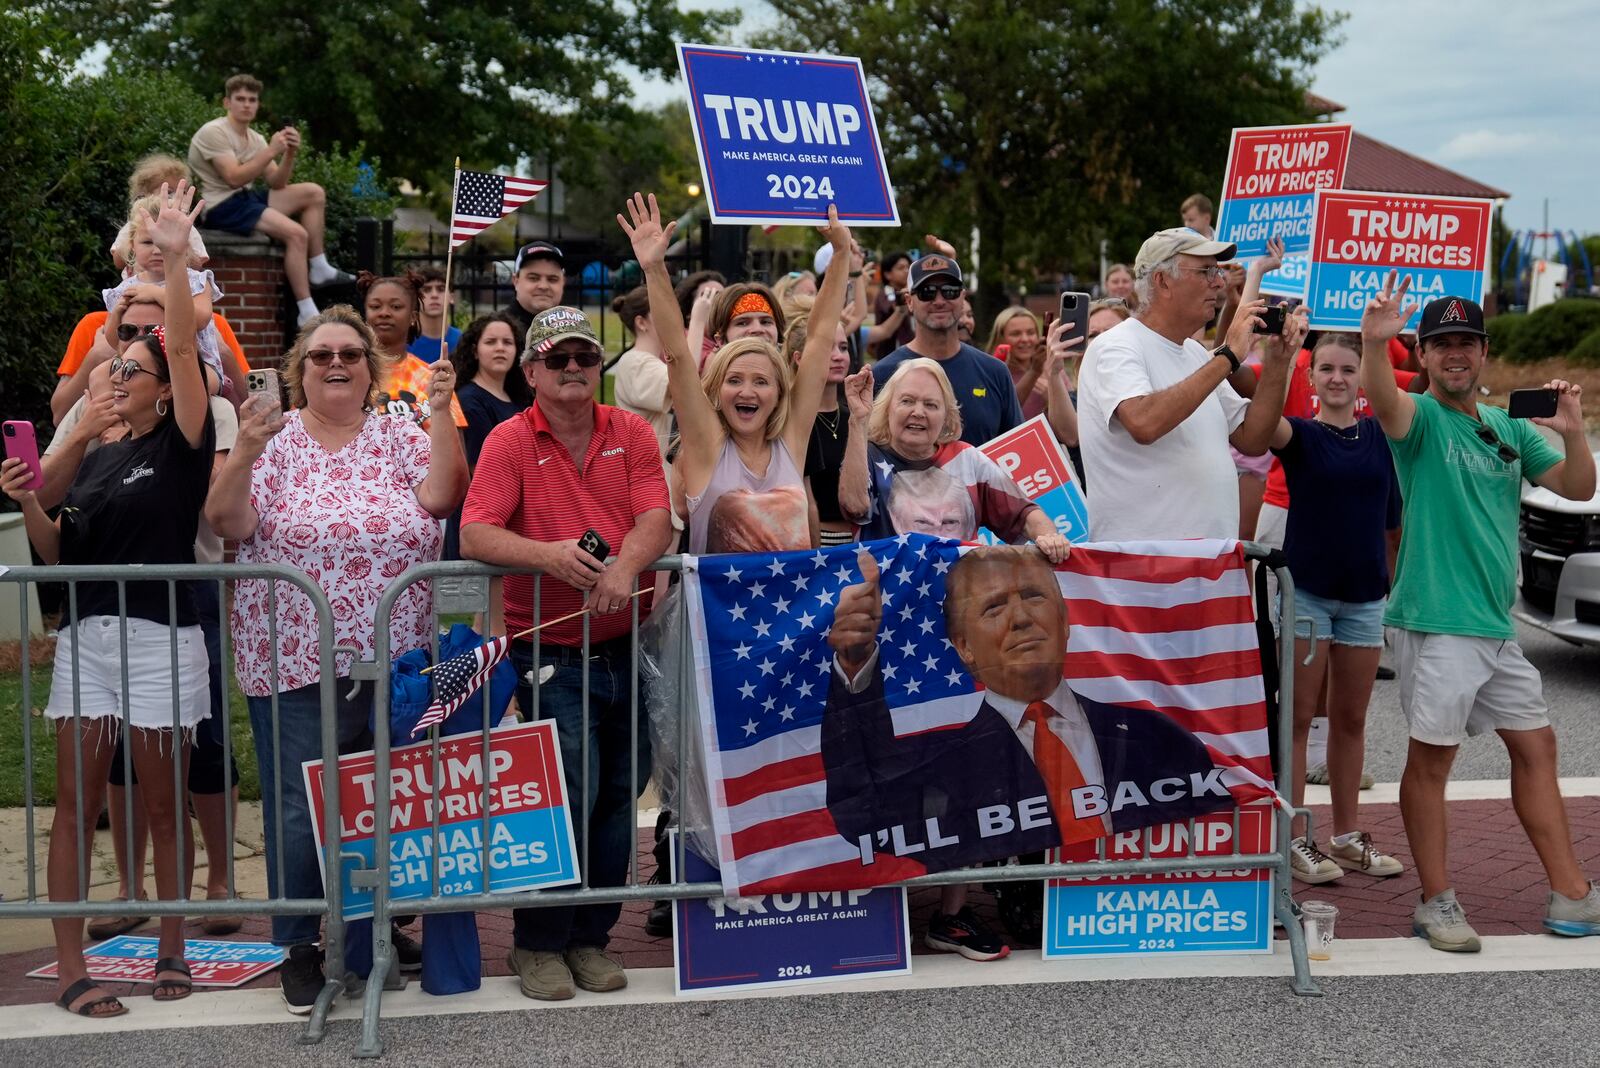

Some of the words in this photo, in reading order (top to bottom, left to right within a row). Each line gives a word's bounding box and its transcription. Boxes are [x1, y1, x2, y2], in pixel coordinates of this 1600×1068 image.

[703, 93, 861, 146] TRUMP
[722, 150, 750, 160] MAKE
[752, 151, 796, 163] AMERICA
[798, 154, 828, 164] GREAT
[831, 156, 863, 165] AGAIN!
[1253, 140, 1330, 171] TRUMP
[766, 173, 835, 200] 2024
[1235, 173, 1276, 195] LOW
[1278, 169, 1335, 192] PRICES
[1248, 198, 1313, 222] KAMALA
[1229, 223, 1269, 242] HIGH
[1272, 218, 1313, 239] PRICE
[1347, 209, 1460, 241] TRUMP
[1326, 239, 1384, 262] LOW
[1389, 242, 1472, 267] PRICES
[540, 310, 585, 327] TRUMP
[602, 447, 625, 456] GEOR
[352, 749, 513, 805] TRUMP
[424, 782, 542, 822] PRICES
[976, 794, 1052, 839] BE
[1070, 767, 1233, 820] BACK
[390, 822, 514, 863] KAMALA
[1096, 822, 1233, 855] RUMP
[438, 841, 549, 879] PRICES
[1096, 889, 1220, 912] KAMALA
[715, 920, 744, 930] MAKE
[747, 916, 793, 928] AMERICA
[796, 912, 829, 923] GREAT
[832, 909, 867, 920] AGAIN!
[1067, 912, 1137, 936] HIGH
[1146, 911, 1248, 933] PRICES
[1138, 939, 1176, 950] 2024
[85, 956, 159, 966] RICES
[189, 962, 258, 970] LOW
[778, 964, 812, 977] 2024
